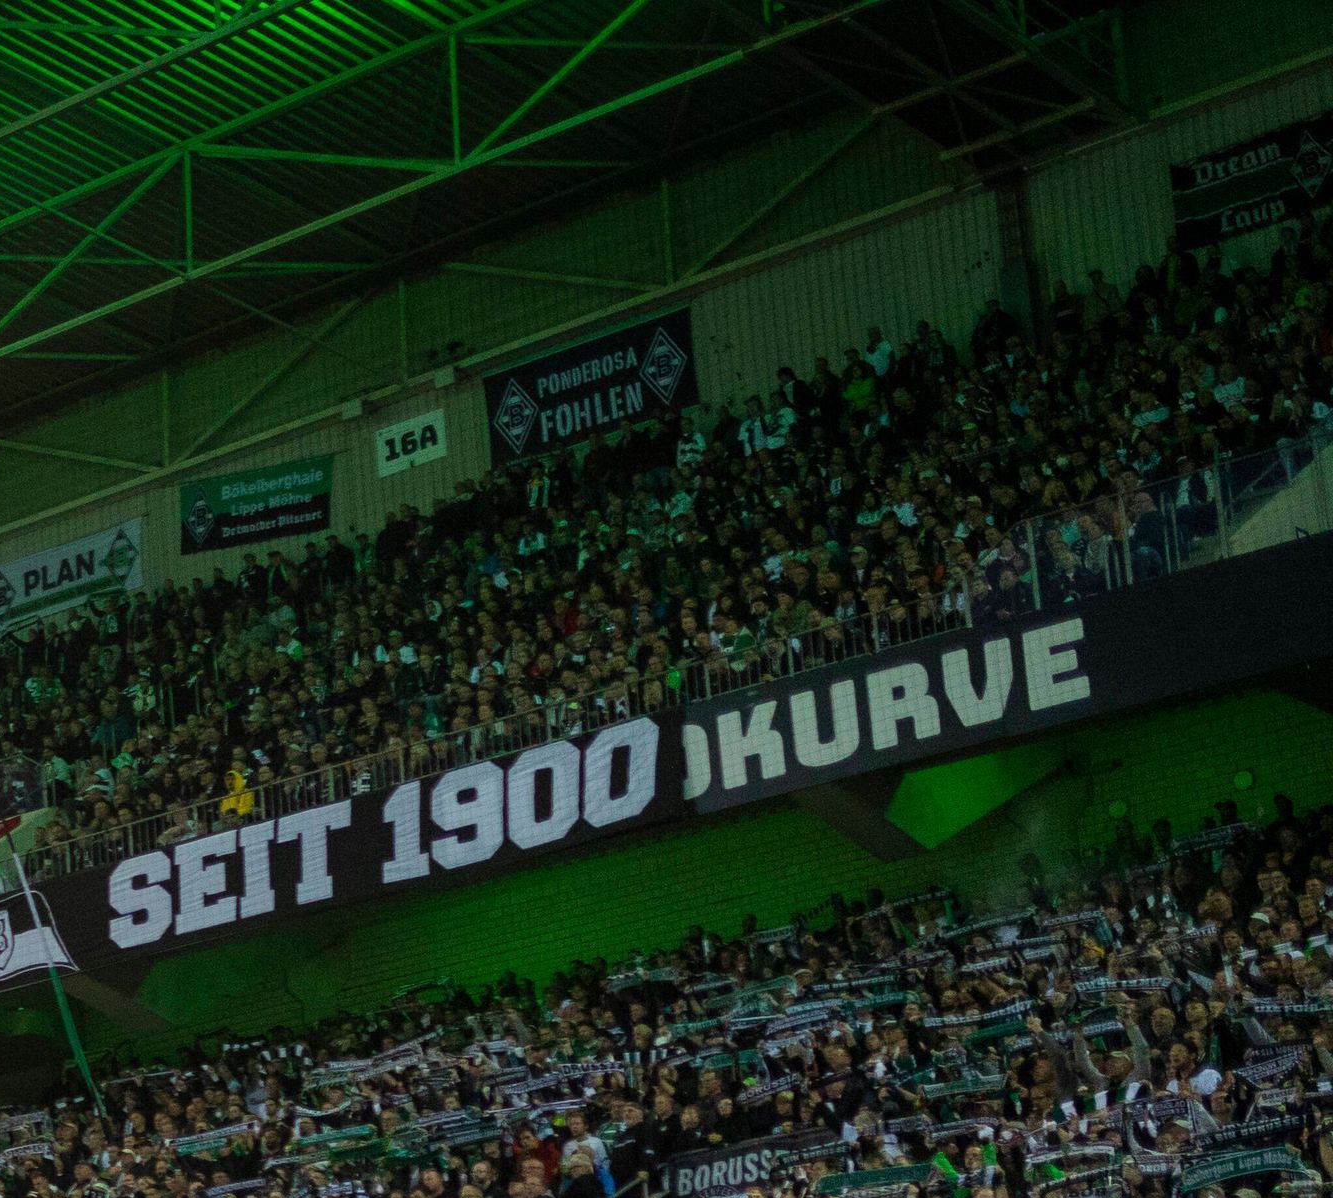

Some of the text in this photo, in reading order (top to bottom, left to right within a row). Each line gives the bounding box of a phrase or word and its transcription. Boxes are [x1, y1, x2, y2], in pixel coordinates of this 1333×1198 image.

[1191, 142, 1281, 184] Dream
[536, 345, 638, 399] PONDEROSA
[539, 381, 645, 443] FOHLEN
[384, 425, 439, 463] 16A
[23, 550, 95, 597] PLAN
[108, 800, 353, 950] SEIT
[382, 716, 660, 885] 1900
